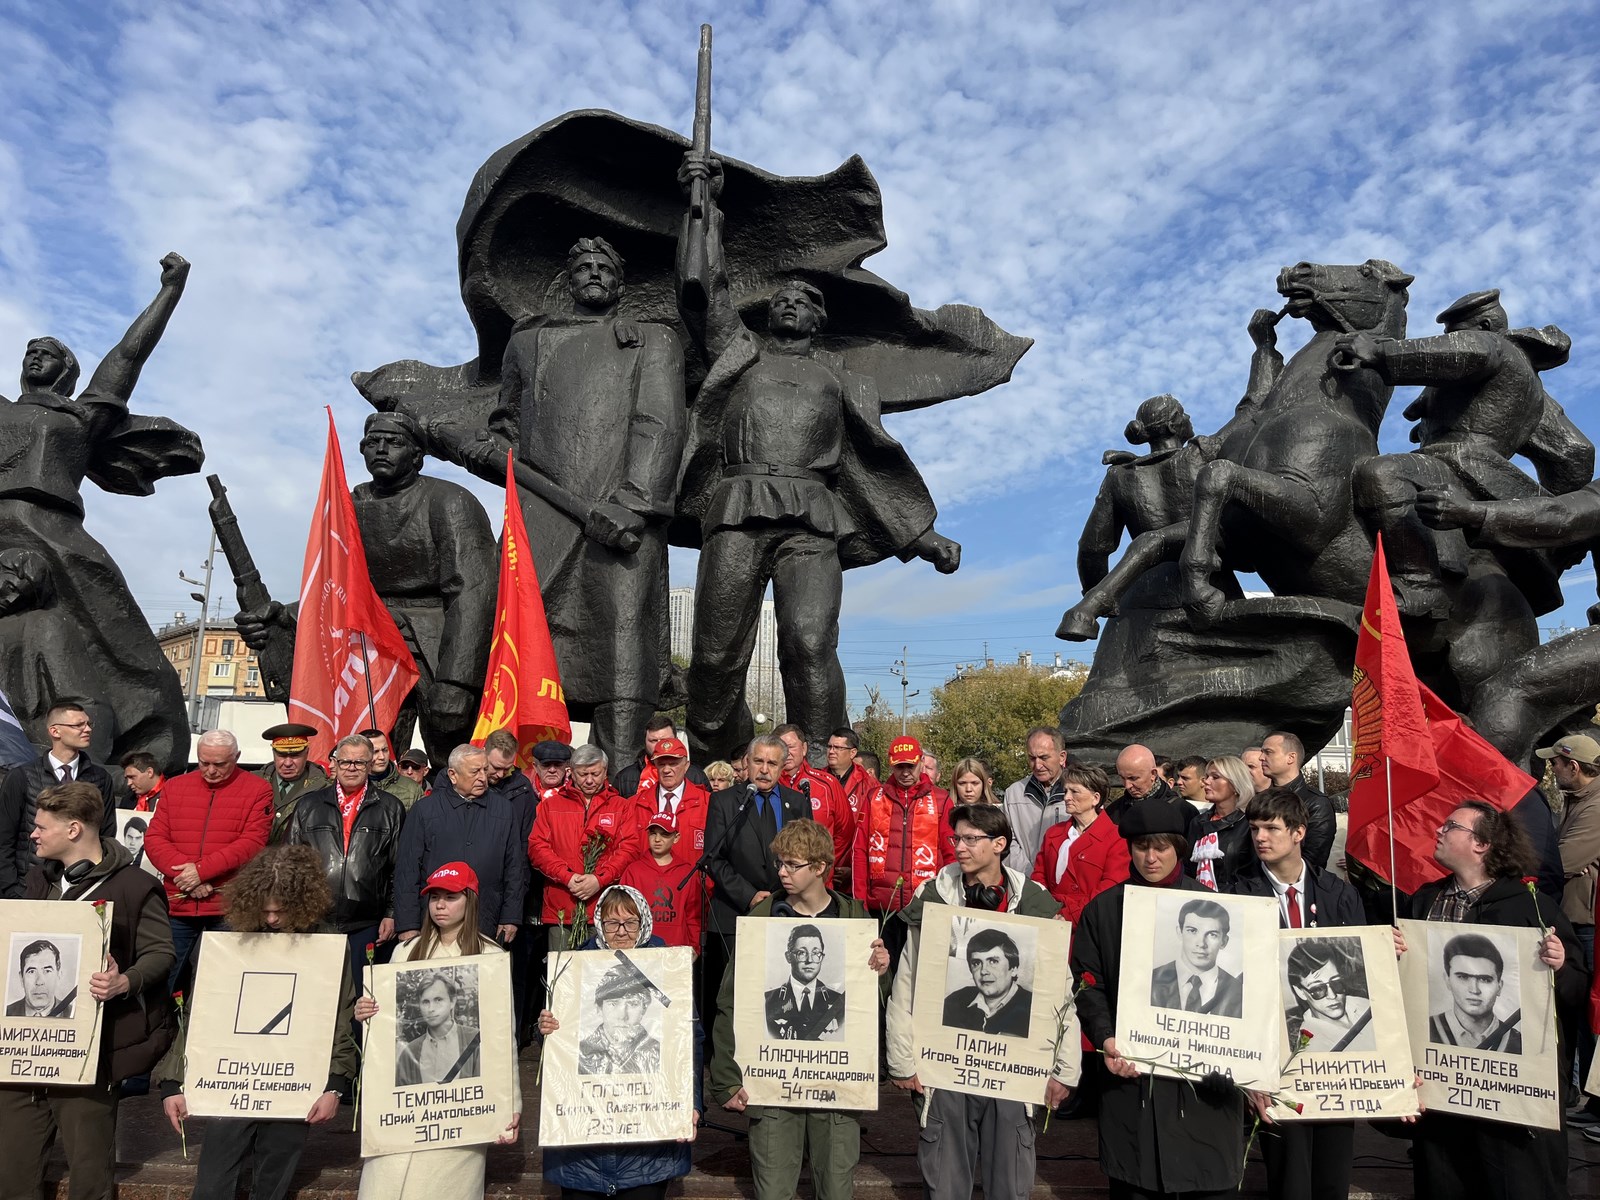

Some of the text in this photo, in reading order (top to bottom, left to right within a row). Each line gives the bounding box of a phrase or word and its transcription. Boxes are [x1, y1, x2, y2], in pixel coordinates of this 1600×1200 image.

[893, 743, 914, 754] СССР
[431, 869, 460, 879] КПРФ
[0, 1025, 76, 1043] МИРХАНОВ
[11, 1059, 33, 1076] 62
[953, 1067, 981, 1087] 38
[781, 1081, 803, 1100] 54
[1448, 1086, 1473, 1108] 20
[230, 1093, 250, 1110] 48
[1316, 1093, 1345, 1111] 23
[414, 1123, 440, 1144] 30
